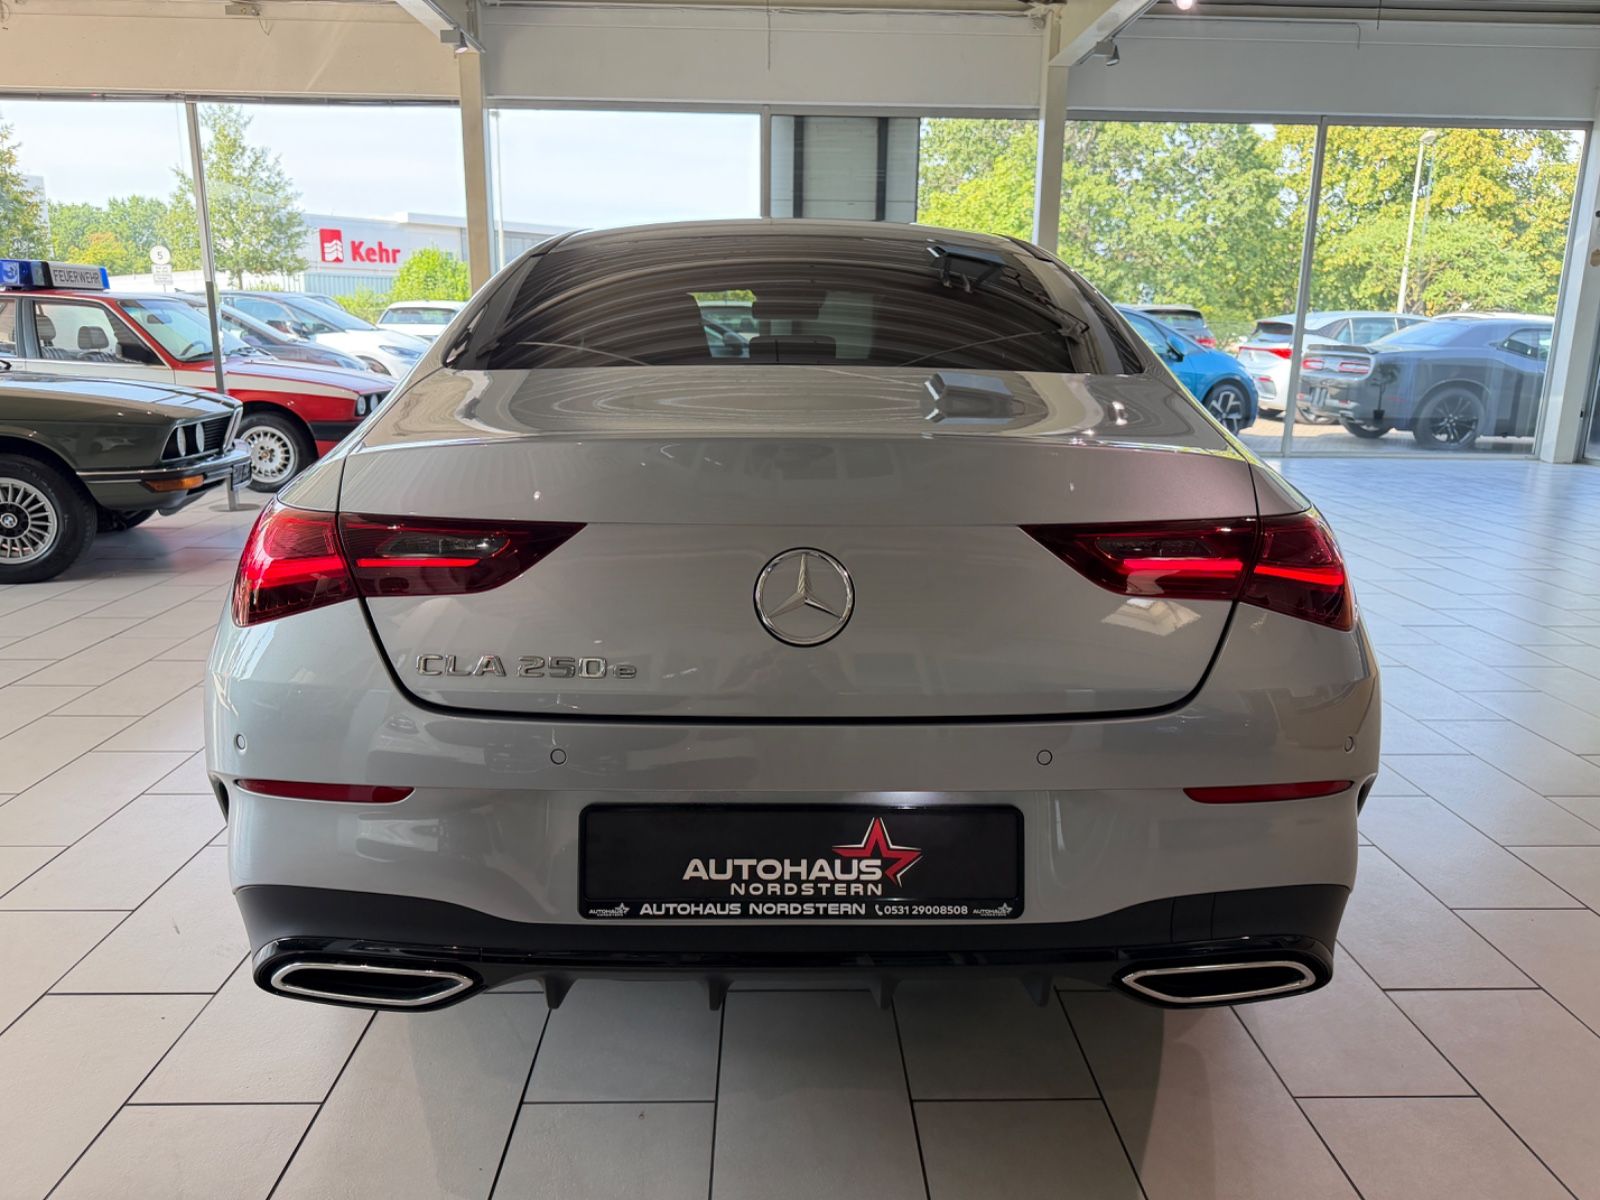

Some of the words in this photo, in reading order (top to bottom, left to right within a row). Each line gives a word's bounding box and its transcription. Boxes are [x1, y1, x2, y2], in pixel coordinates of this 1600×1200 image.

[350, 240, 401, 263] Kehr
[52, 269, 100, 285] FEUERWEHR
[416, 654, 507, 677] CLA
[682, 858, 883, 881] AUTOHAUS
[730, 883, 883, 896] NORDSTERN
[639, 903, 742, 916] AUTOHAUS
[749, 903, 866, 916] NORDSTERN
[883, 905, 909, 915] 0531
[911, 905, 968, 915] 29008508
